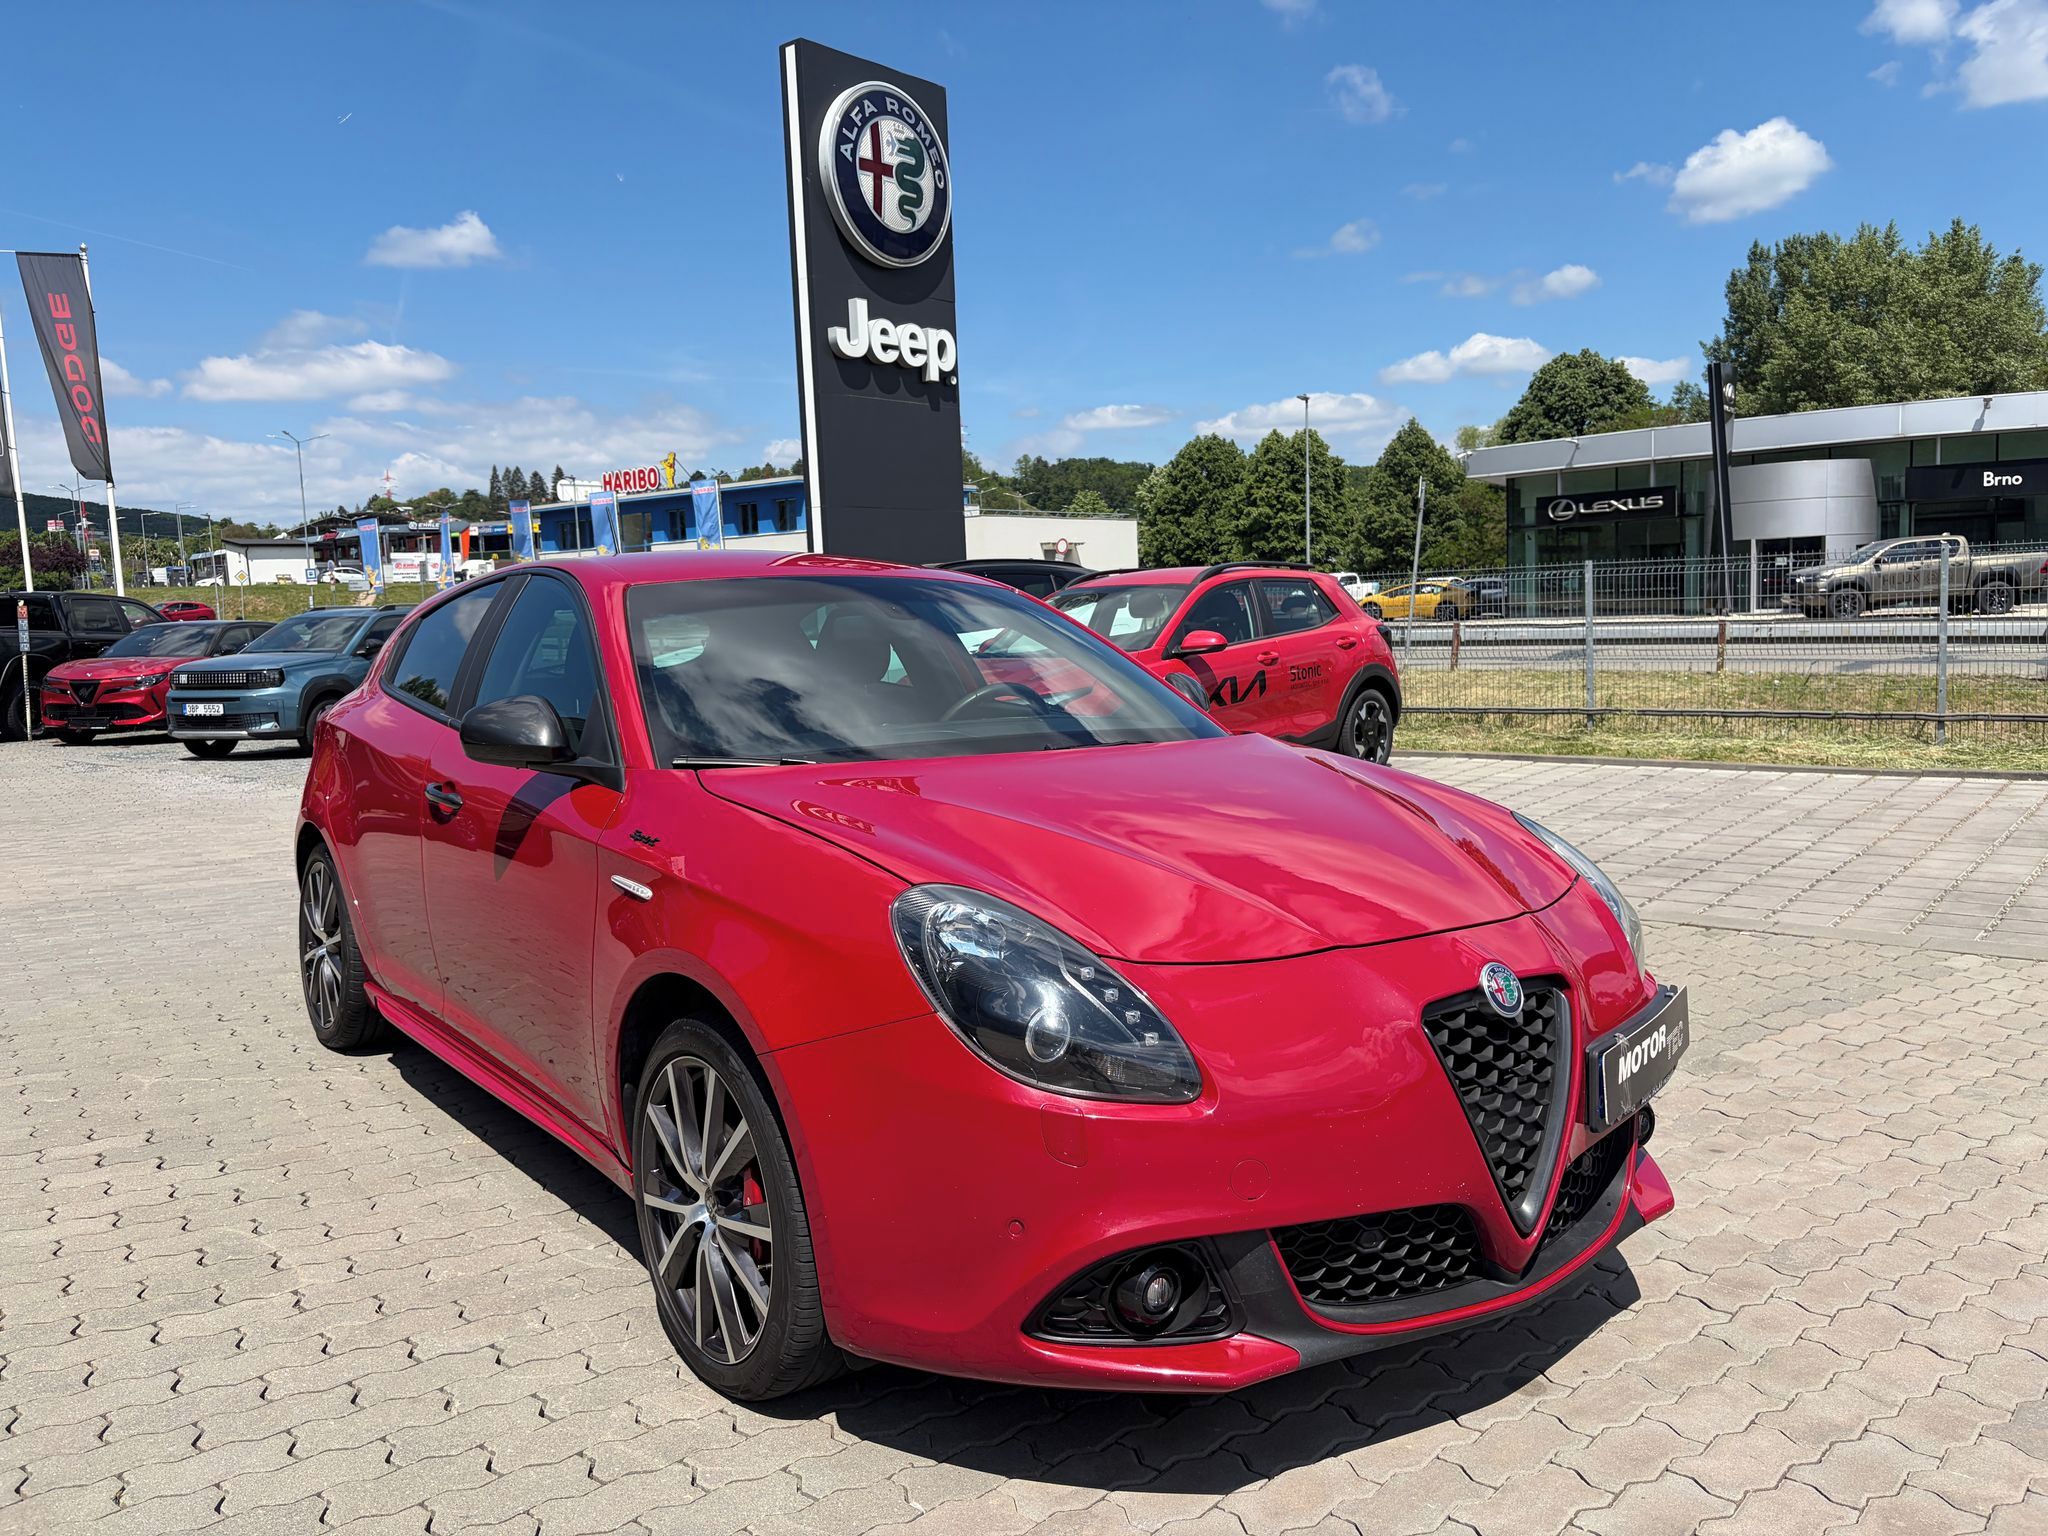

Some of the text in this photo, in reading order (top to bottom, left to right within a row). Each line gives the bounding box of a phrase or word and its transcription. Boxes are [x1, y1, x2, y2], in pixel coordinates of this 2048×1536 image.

[838, 95, 945, 190] ALFA ROMEO
[828, 297, 957, 383] Jeep
[601, 466, 659, 492] HARIBO
[1983, 471, 2023, 487] Brno
[1579, 495, 1664, 514] LEXUS
[1289, 664, 1322, 682] Stonic
[203, 704, 221, 713] 5552
[1618, 1024, 1667, 1085] MOTOR
